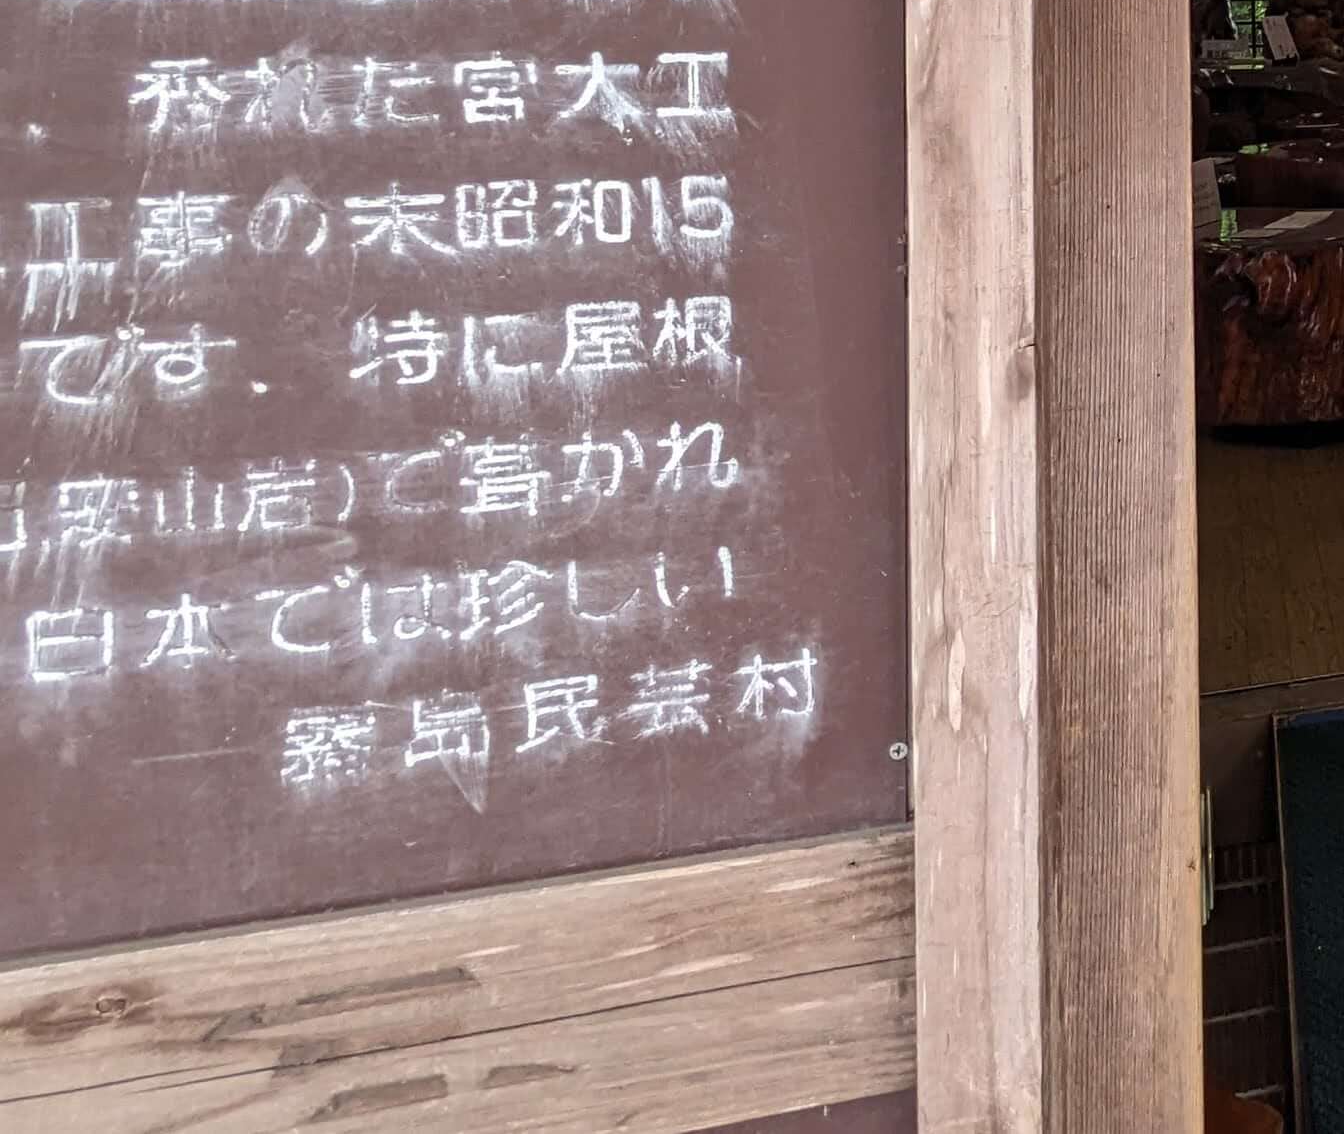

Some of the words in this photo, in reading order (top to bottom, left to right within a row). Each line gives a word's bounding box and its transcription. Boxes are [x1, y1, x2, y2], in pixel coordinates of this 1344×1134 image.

[25, 547, 736, 684] 日本では珍しい
